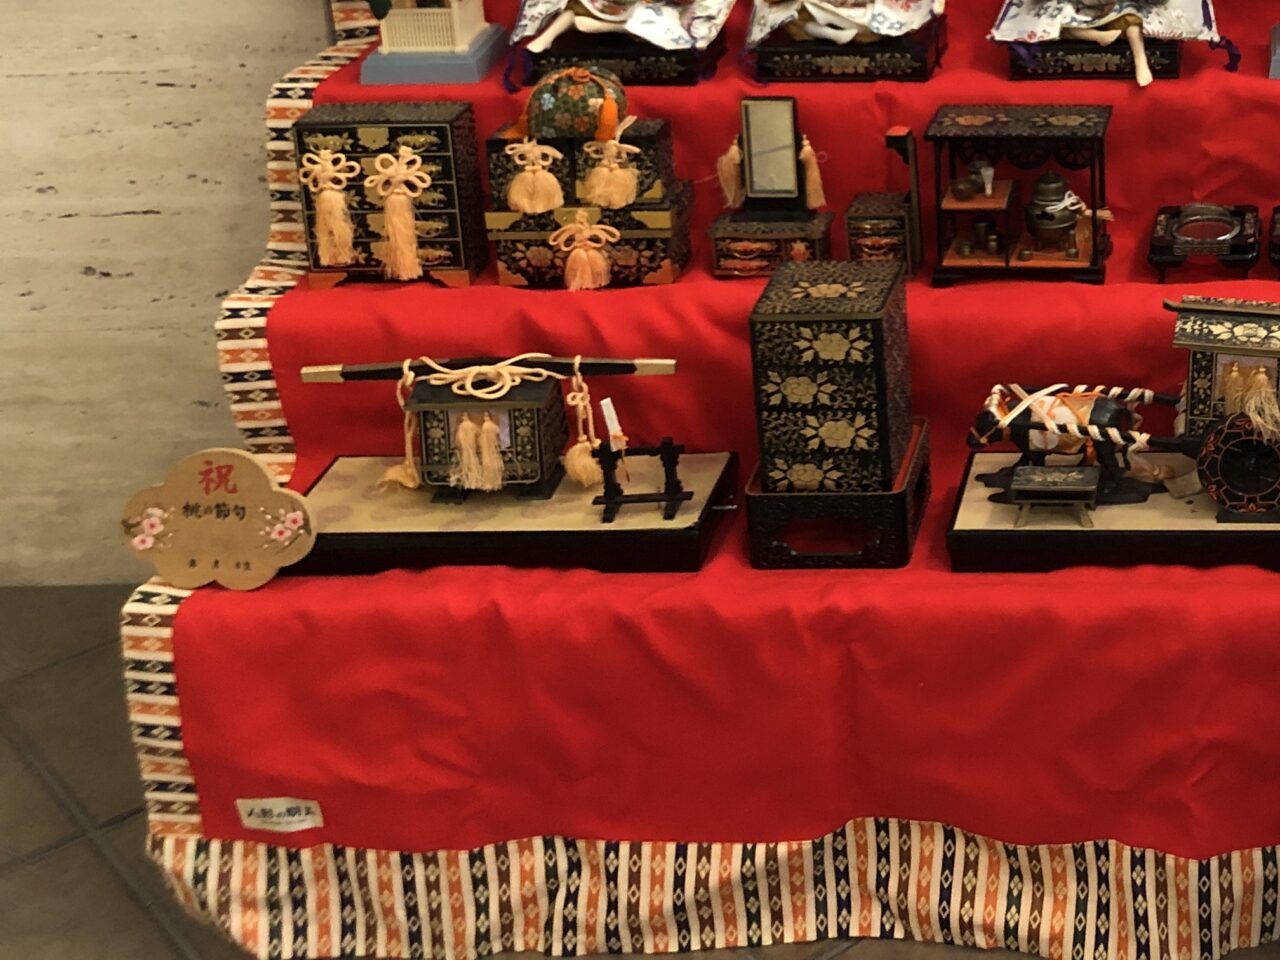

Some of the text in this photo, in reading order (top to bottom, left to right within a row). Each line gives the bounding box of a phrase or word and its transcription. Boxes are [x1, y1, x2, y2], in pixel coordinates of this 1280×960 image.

[197, 460, 239, 496] 祝
[181, 501, 247, 521] 桃の節句
